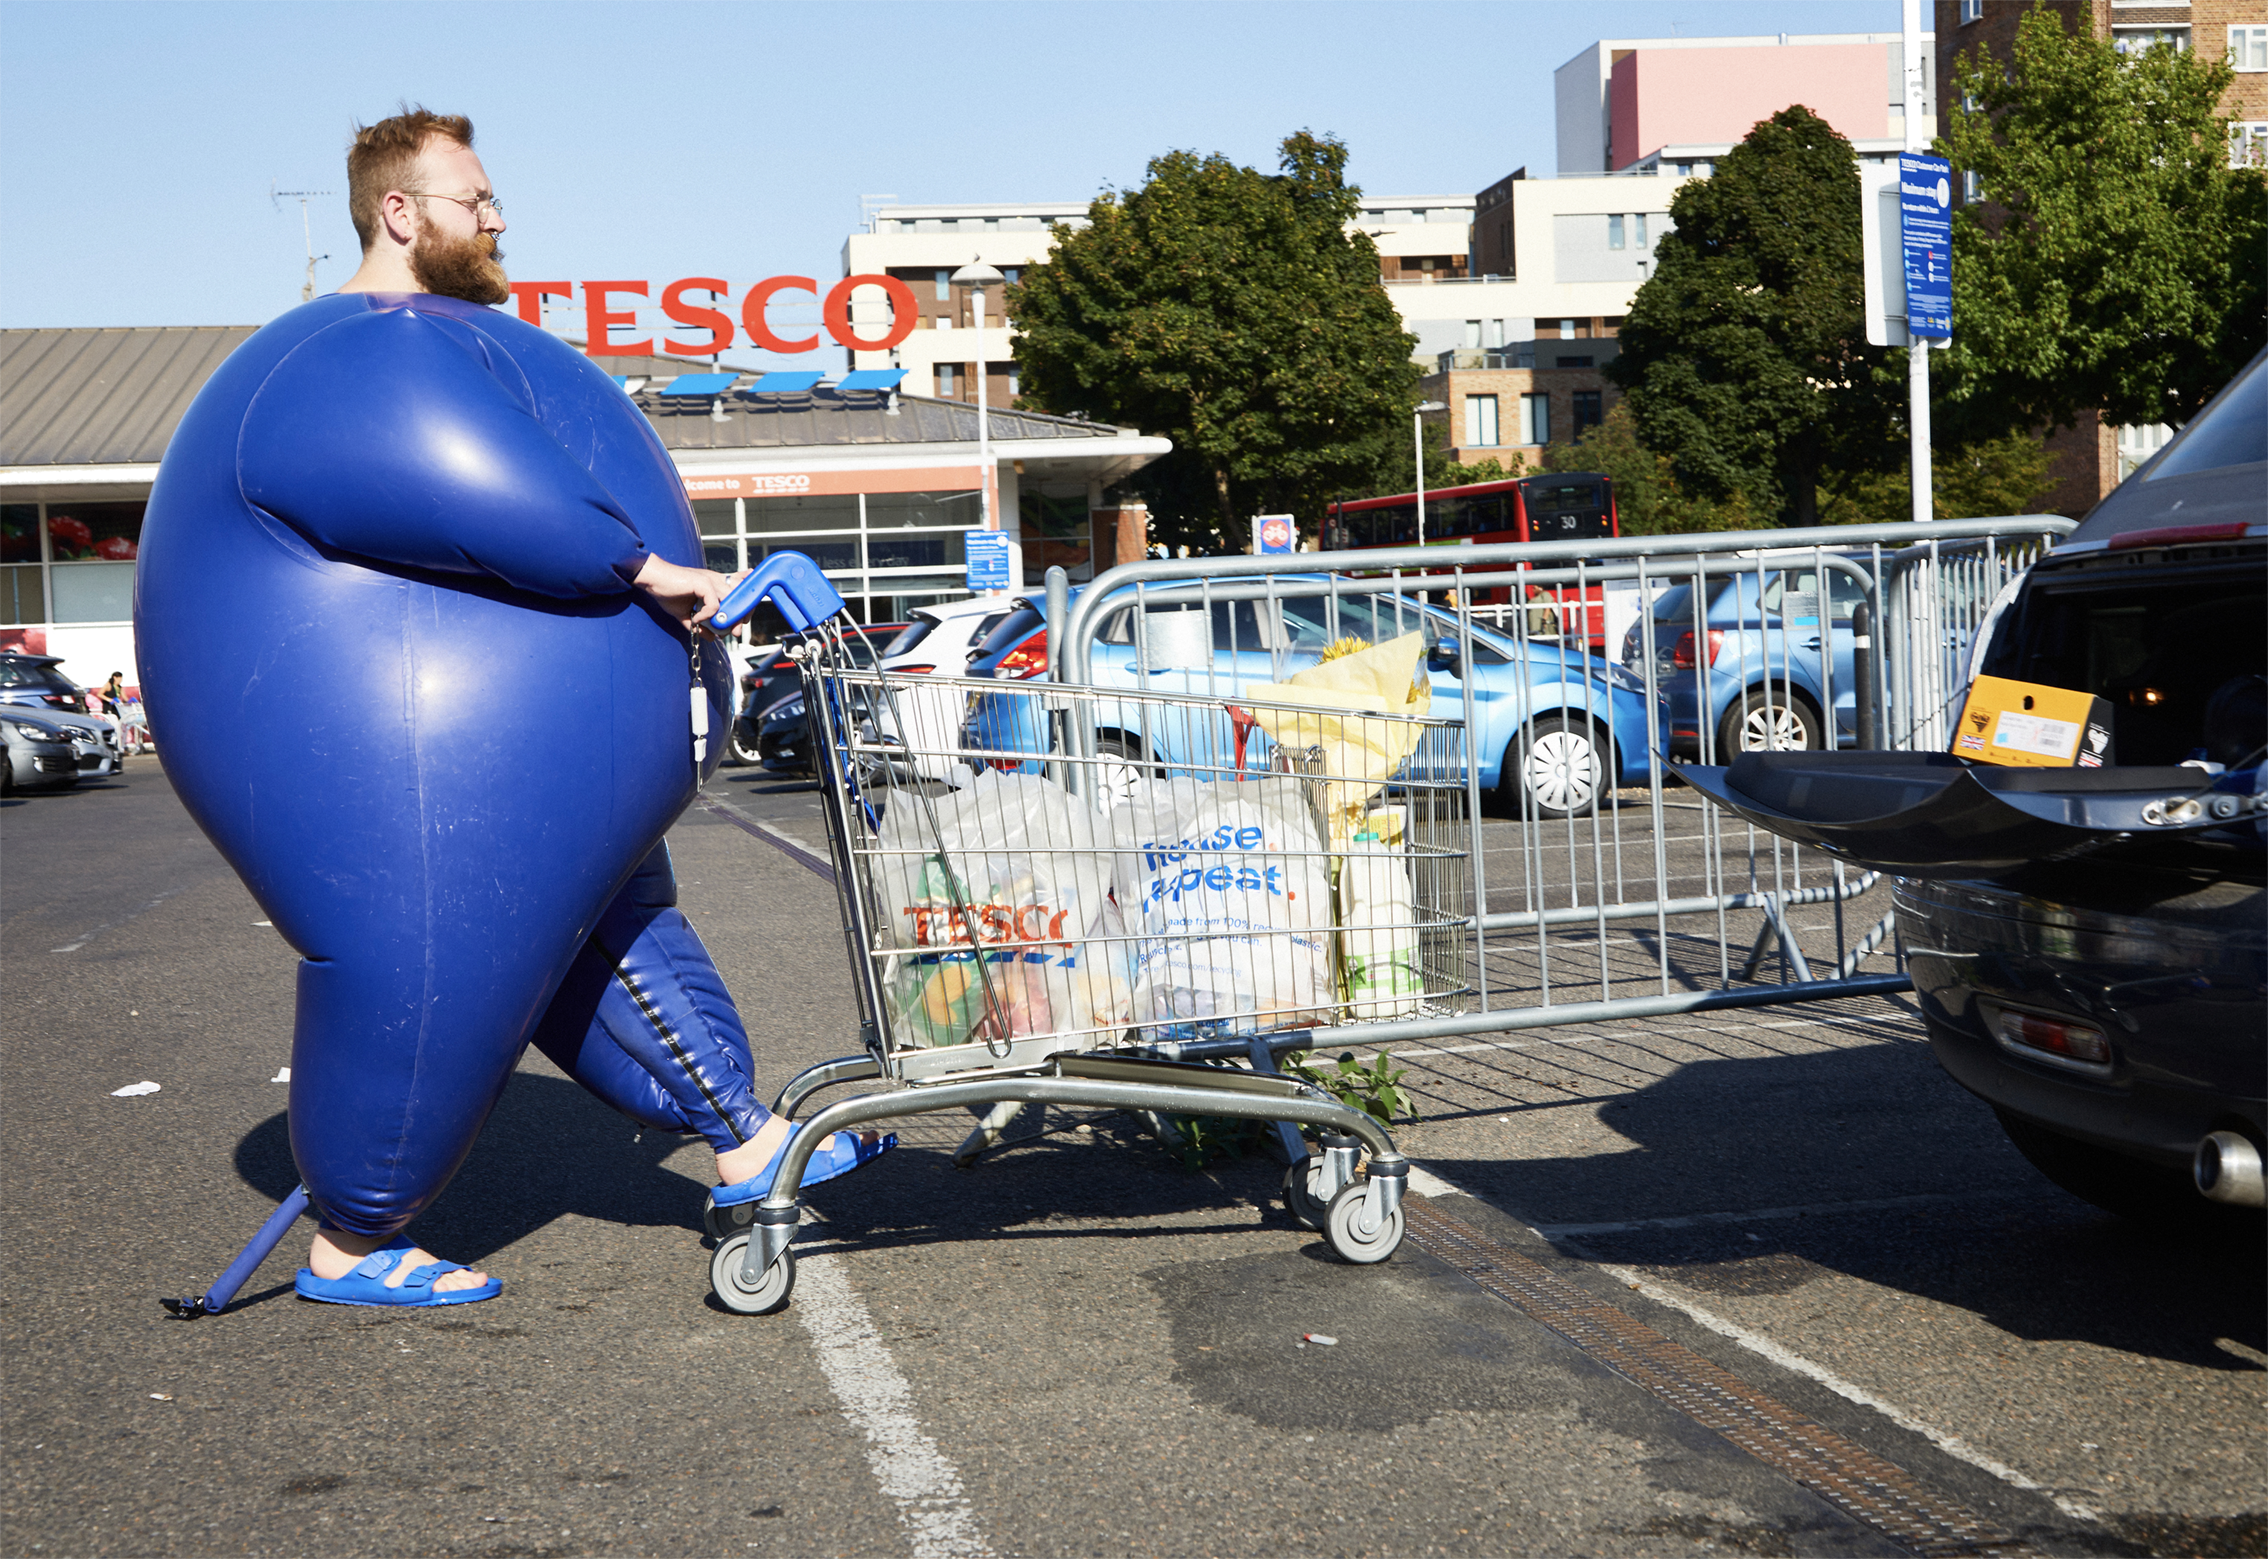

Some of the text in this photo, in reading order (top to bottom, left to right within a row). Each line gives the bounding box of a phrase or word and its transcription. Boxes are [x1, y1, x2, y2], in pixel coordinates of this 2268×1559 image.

[508, 273, 919, 357] TESCO
[683, 474, 810, 491] lcome to TESCO
[1560, 515, 1577, 530] 30
[848, 557, 886, 568] eery
[1195, 917, 1220, 926] from
[1223, 917, 1249, 930] 100%
[1240, 934, 1263, 948] can.
